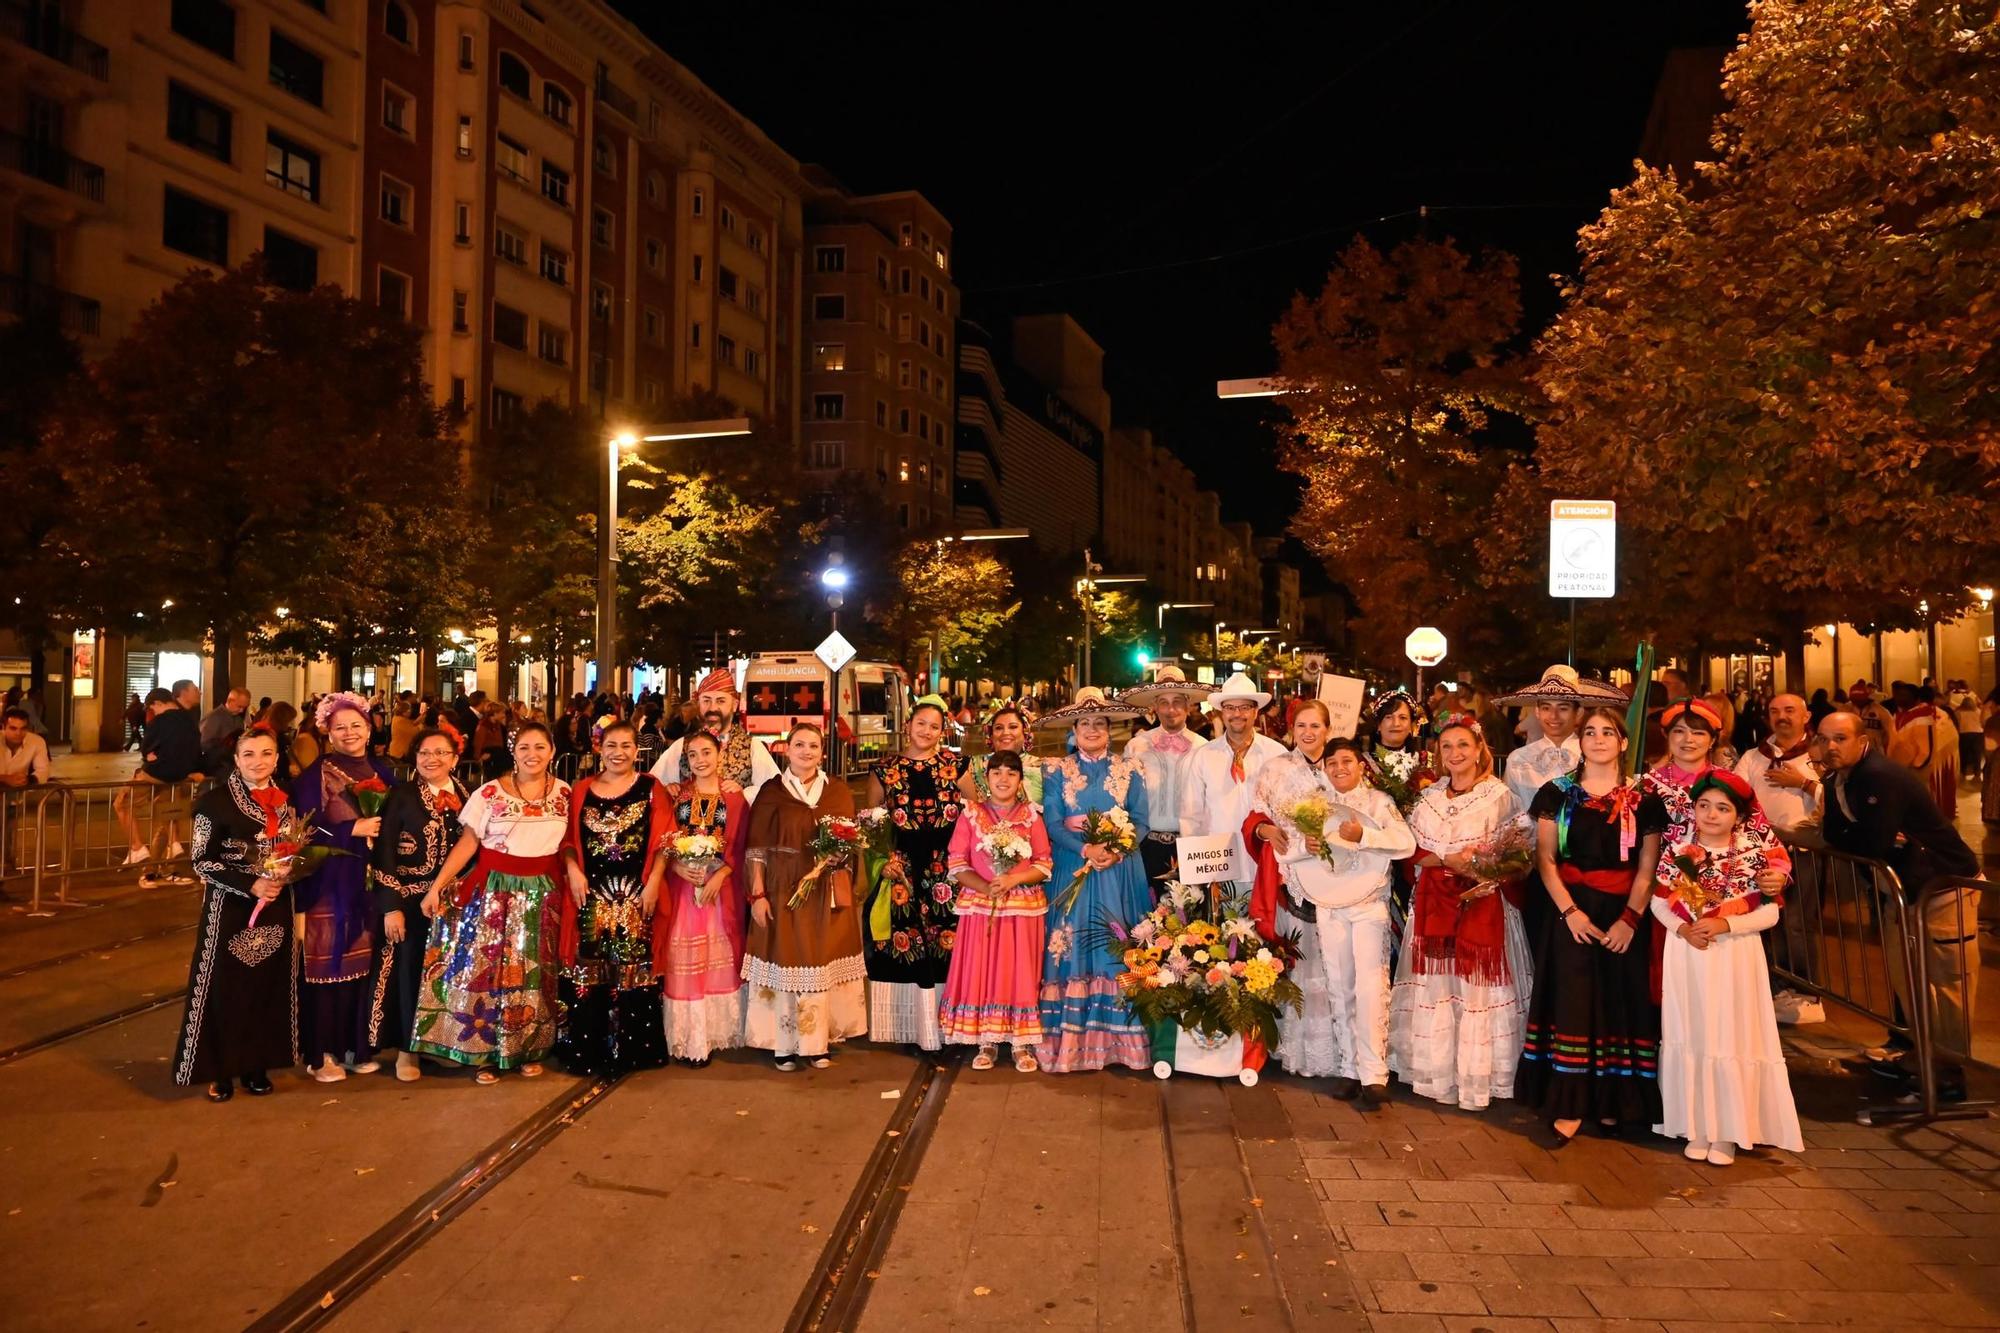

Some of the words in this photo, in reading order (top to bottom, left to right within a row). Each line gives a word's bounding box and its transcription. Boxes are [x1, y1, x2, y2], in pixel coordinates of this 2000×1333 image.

[1557, 572, 1608, 580] PRIORIDAD
[1558, 584, 1607, 592] PEATONAL
[756, 667, 817, 676] AMBULANCIA
[1187, 850, 1222, 861] AMIGOS
[1223, 848, 1234, 858] DE
[1196, 862, 1229, 874] MÉXICO
